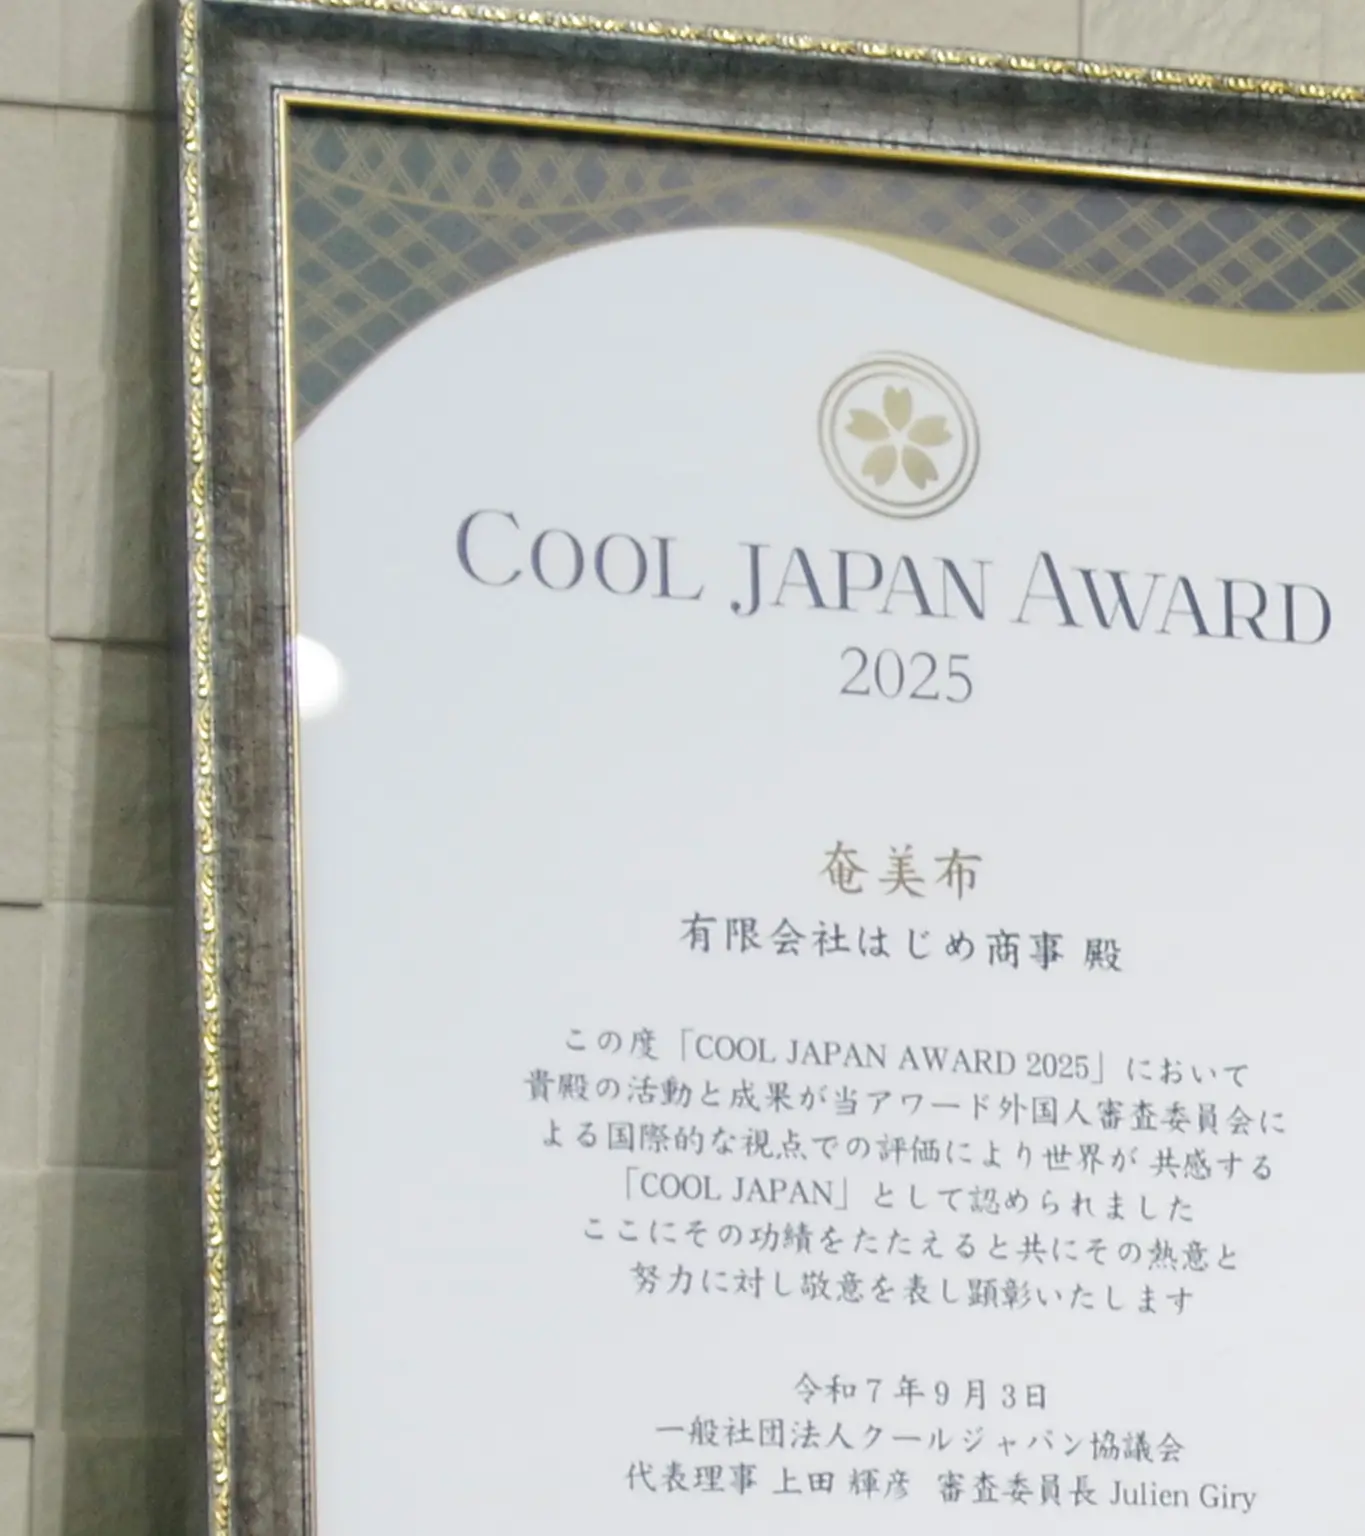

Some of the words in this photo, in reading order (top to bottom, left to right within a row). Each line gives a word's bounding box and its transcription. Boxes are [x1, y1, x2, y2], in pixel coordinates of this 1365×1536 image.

[731, 541, 993, 621] JAPAN
[840, 645, 975, 705] 2025
[820, 839, 984, 901] 奄美布
[680, 911, 1065, 973] 有限会社はじめ商事
[1084, 937, 1124, 973] 殿
[785, 1040, 888, 1071] JAPAN
[898, 1045, 1017, 1077] AWARD
[525, 1067, 1287, 1136] 貴殿の活動と成果が当アワード外国人審査委員会に
[542, 1118, 1274, 1181] よる国際的な視点での評価により世界が共感する
[583, 1216, 1239, 1273] ここにその功績をたたえると共にその熱意と
[655, 1415, 1186, 1464] 一般社団法人クールジャパン協議会
[1109, 1479, 1190, 1510] Julien
[1198, 1483, 1257, 1515] Giry
